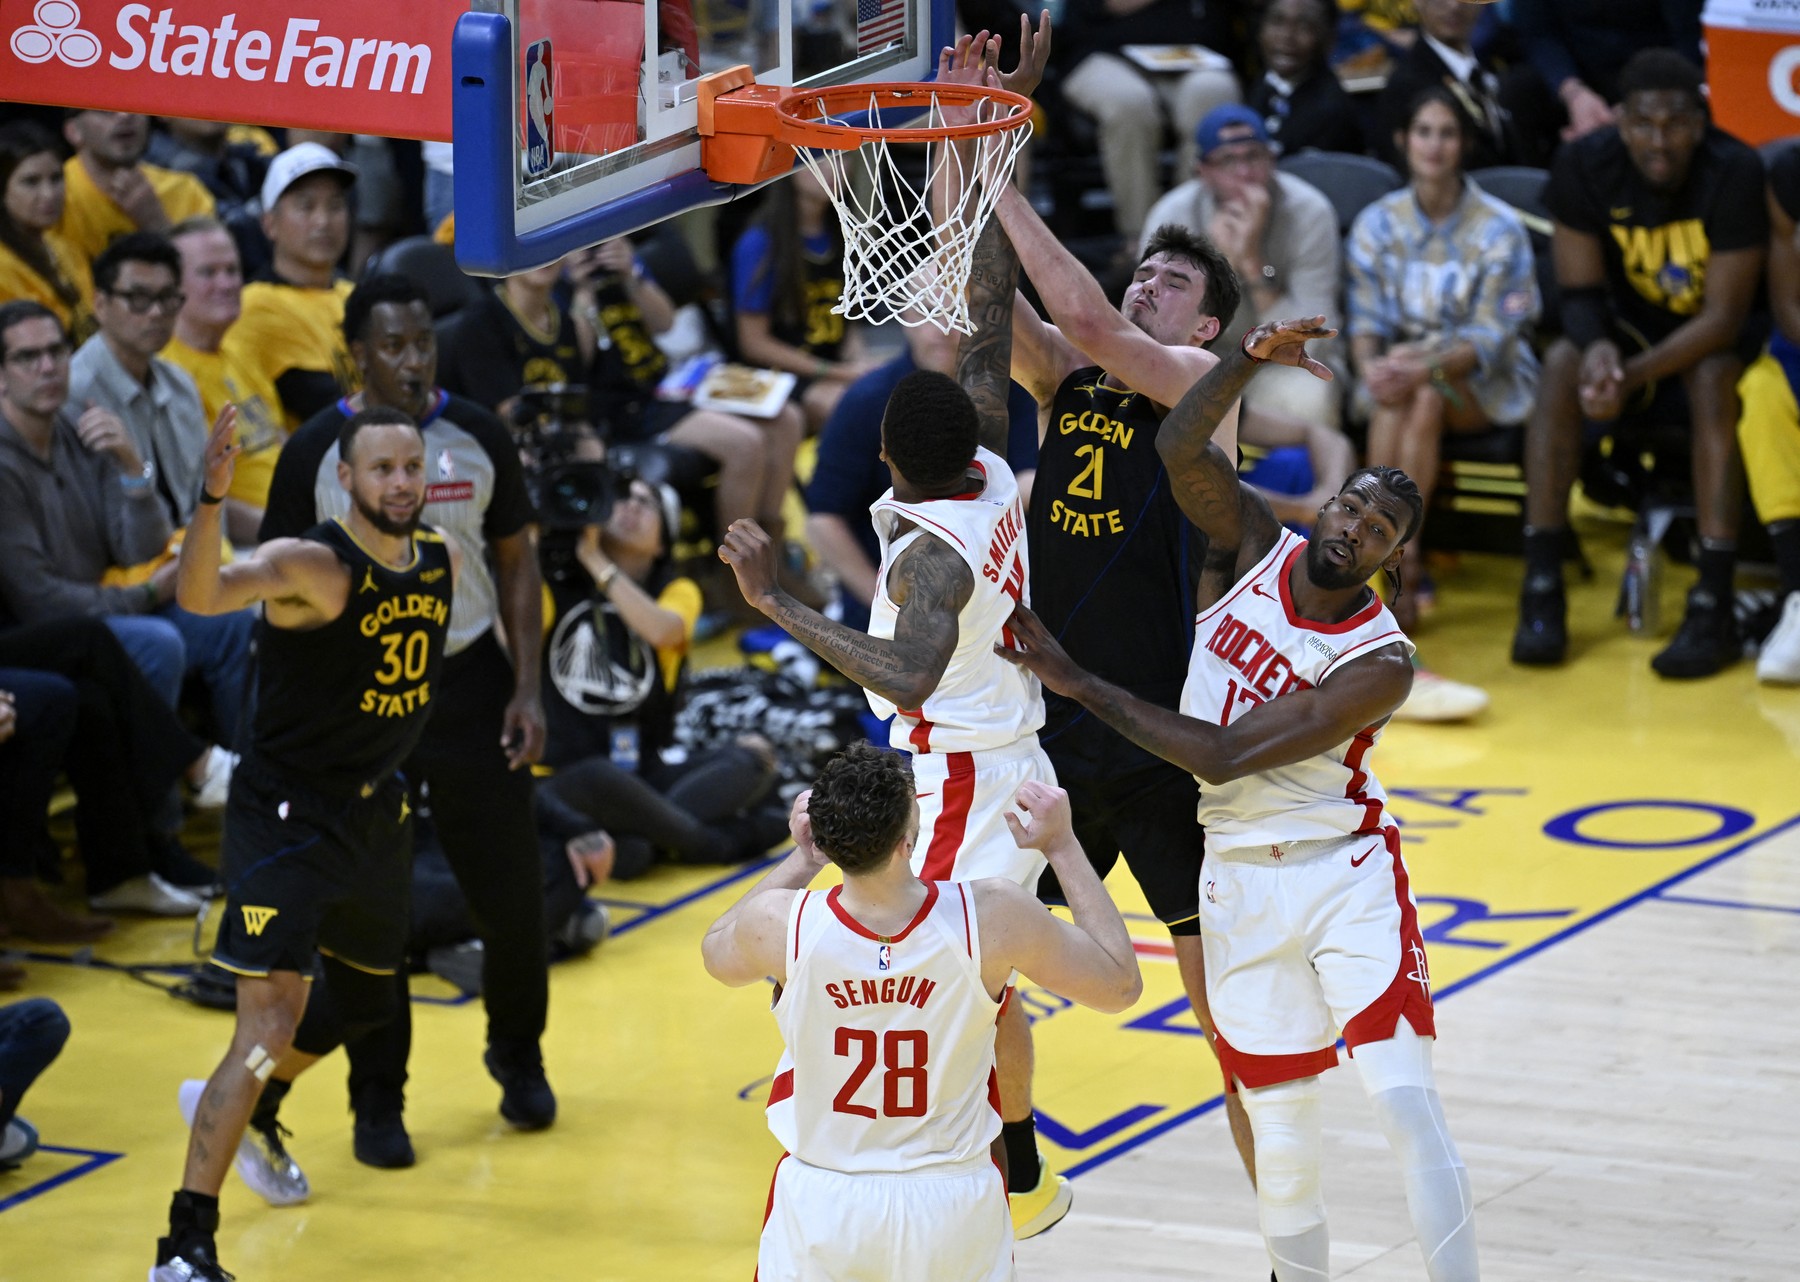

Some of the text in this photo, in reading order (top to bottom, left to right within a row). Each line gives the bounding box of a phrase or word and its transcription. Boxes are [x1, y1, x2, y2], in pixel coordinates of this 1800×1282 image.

[530, 144, 545, 168] NBA
[1060, 410, 1135, 450] GODEN
[1067, 444, 1104, 500] 21
[1050, 500, 1124, 537] STATE
[982, 508, 1018, 583] SMITH
[360, 594, 448, 637] GOLDEN
[374, 630, 429, 685] 30
[791, 622, 818, 639] power
[830, 638, 847, 653] God
[1205, 612, 1317, 699] ROCKET
[1309, 635, 1338, 659] MEMORIA
[360, 681, 430, 718] STATE
[825, 976, 936, 1009] SENGUN
[833, 1026, 928, 1120] 28
